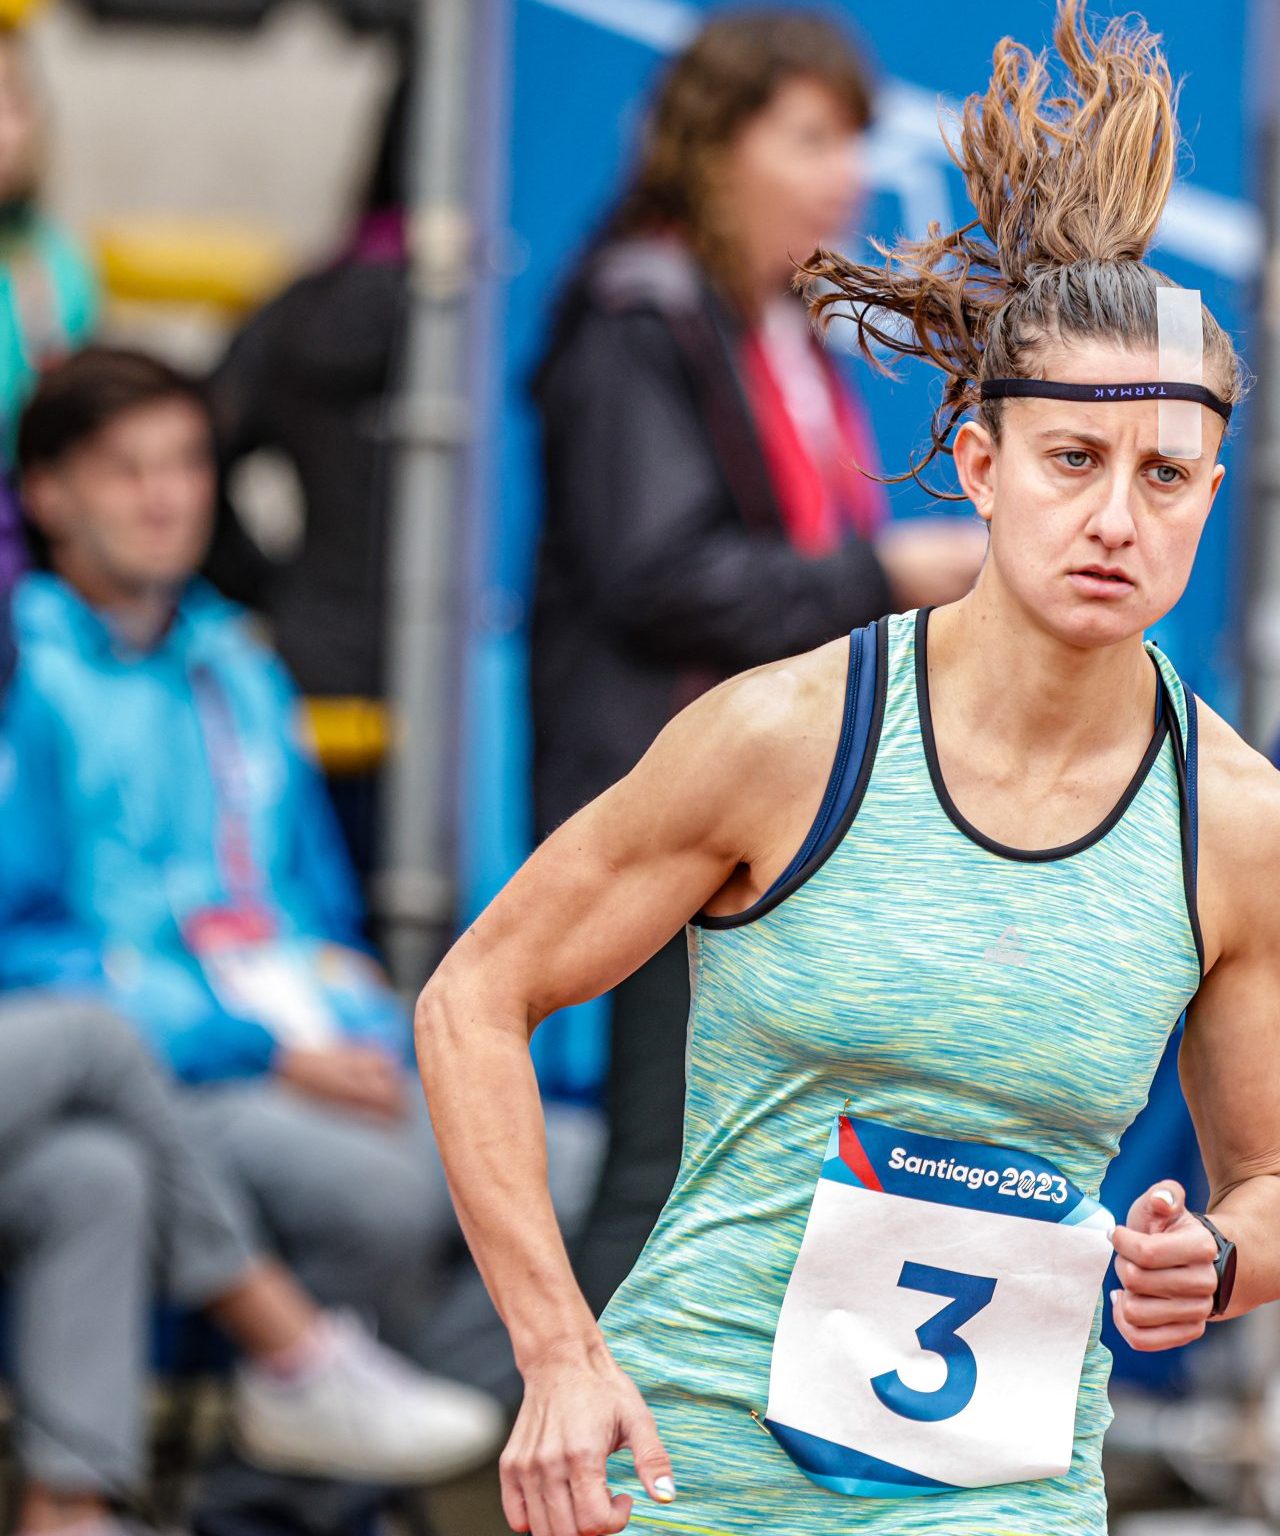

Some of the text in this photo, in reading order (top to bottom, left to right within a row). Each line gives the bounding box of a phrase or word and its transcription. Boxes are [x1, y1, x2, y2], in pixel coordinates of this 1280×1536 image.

[1094, 386, 1167, 398] TARMAK
[888, 1147, 1068, 1204] Santiago 2023
[870, 1260, 998, 1422] 3
